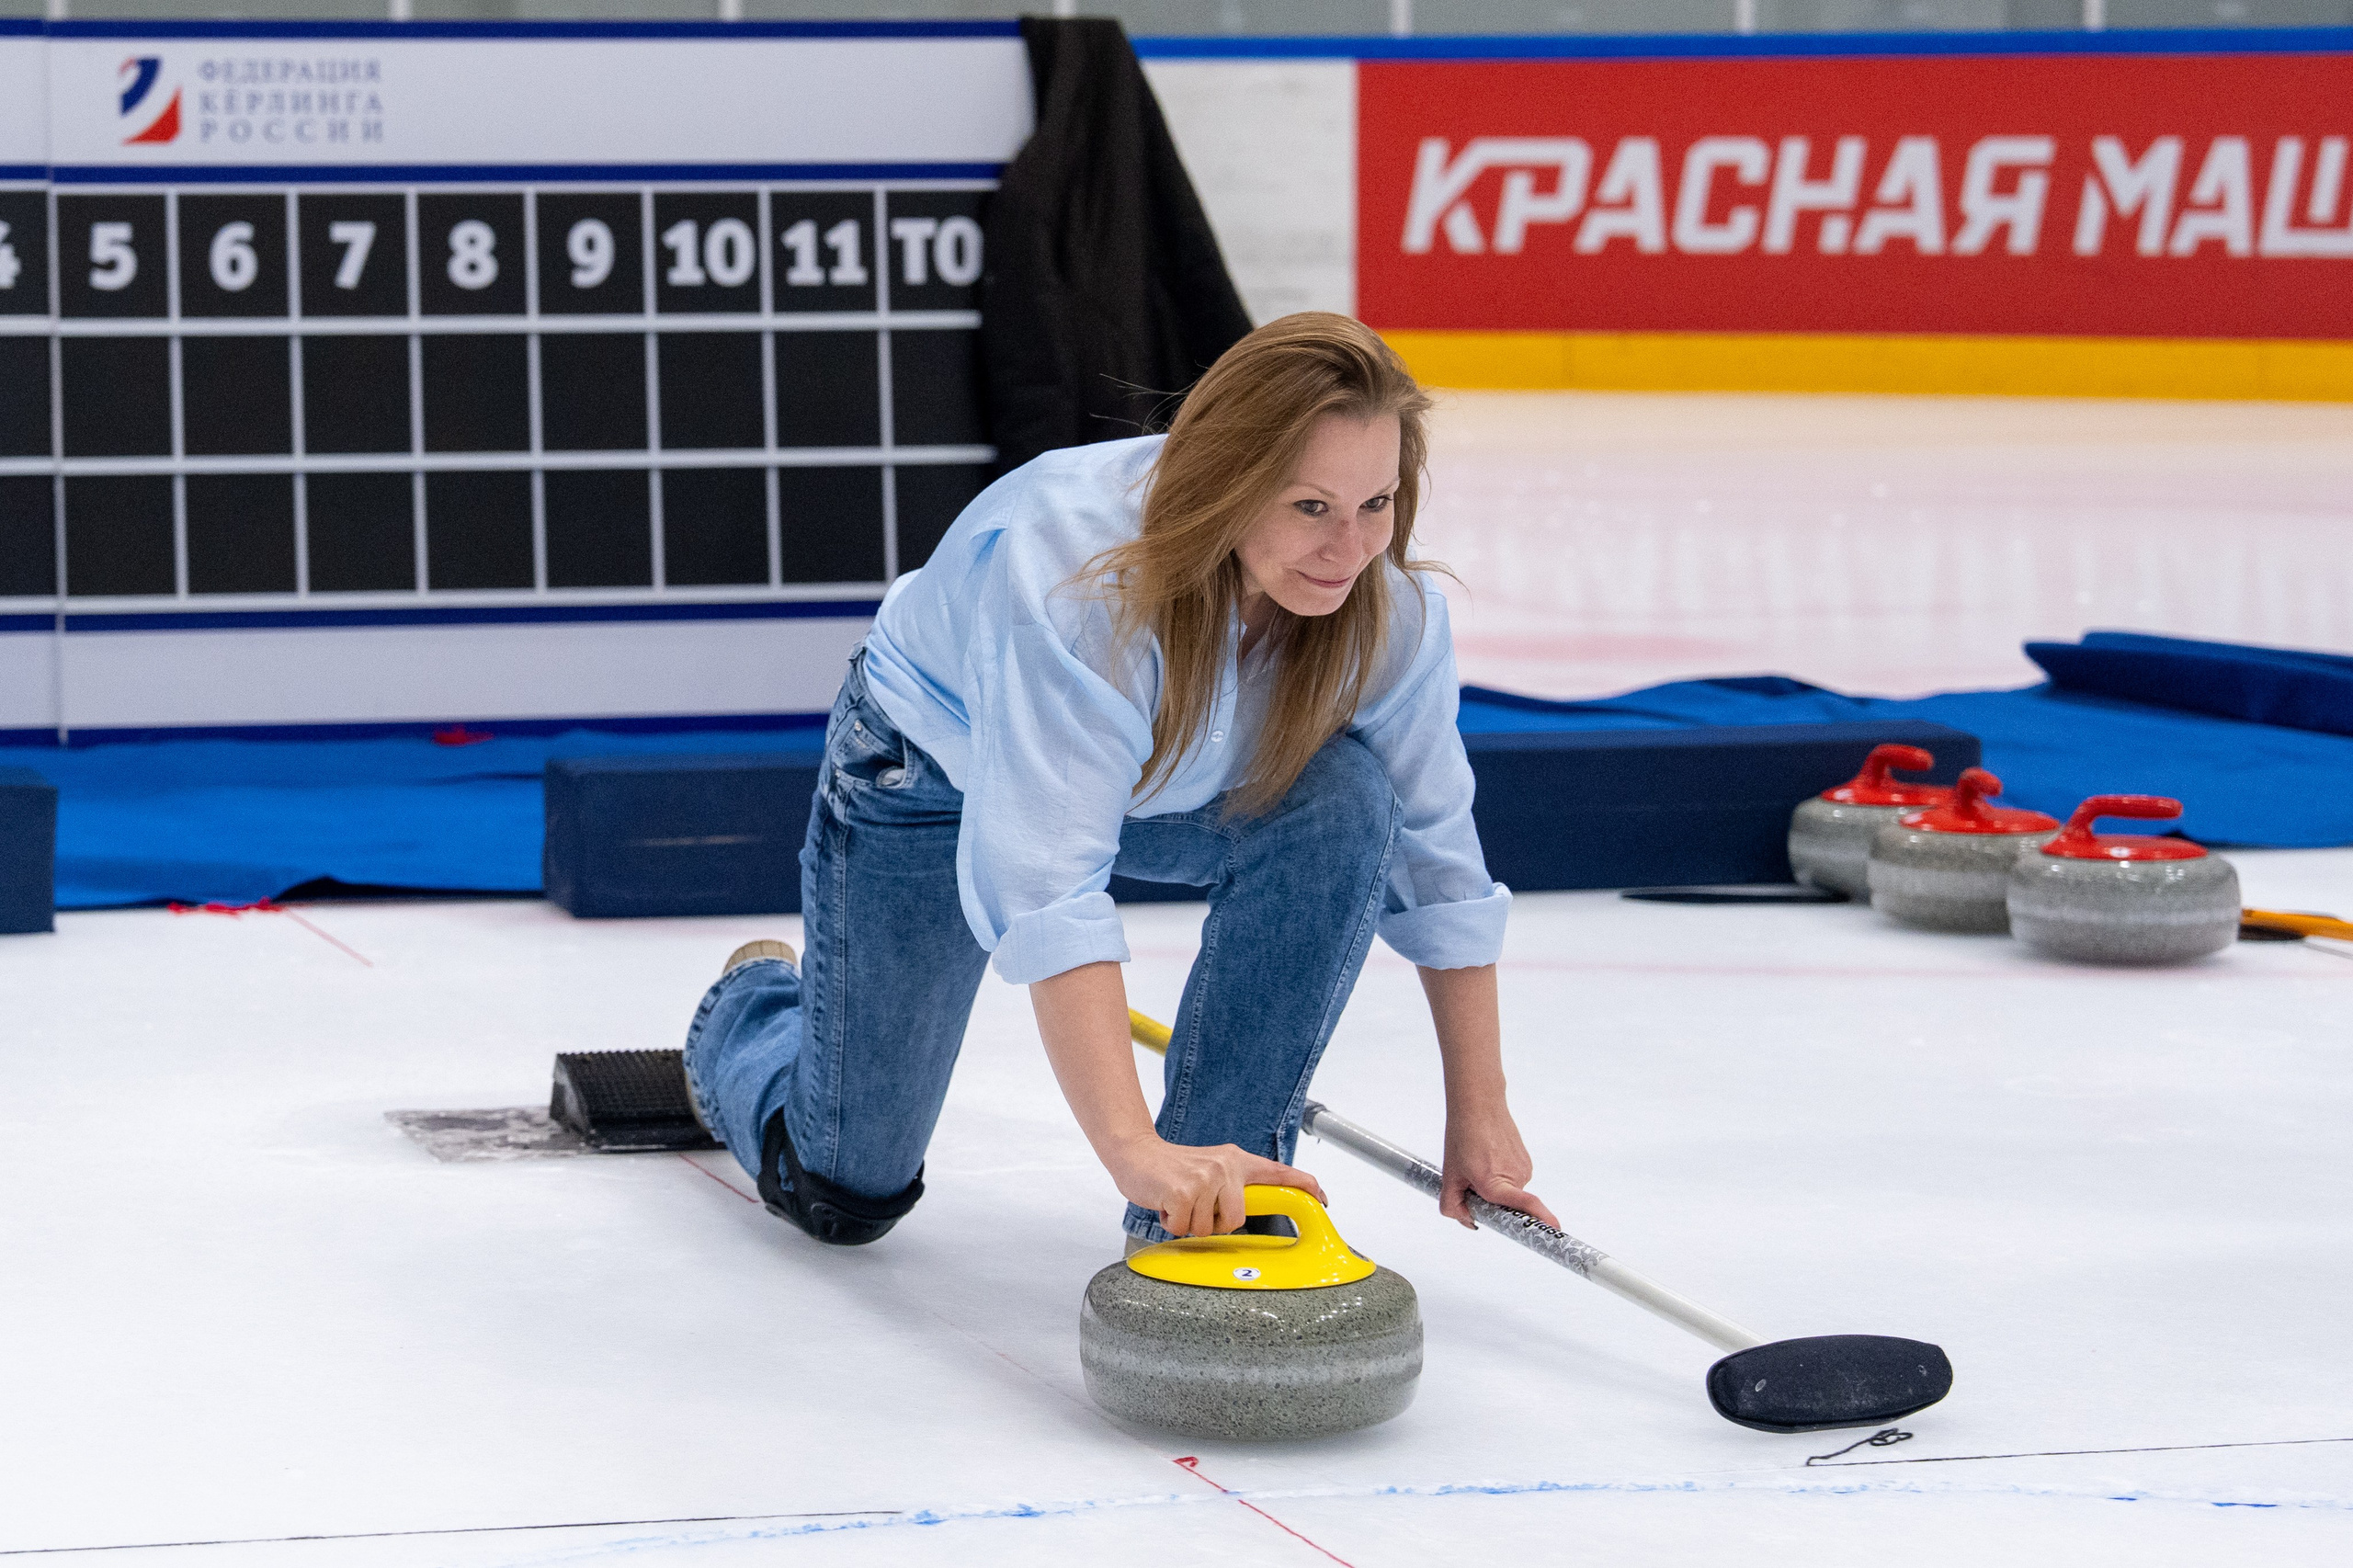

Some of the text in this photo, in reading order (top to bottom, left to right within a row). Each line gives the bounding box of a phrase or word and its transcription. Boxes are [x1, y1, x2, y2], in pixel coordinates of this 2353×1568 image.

[198, 59, 381, 84] ФЕДЕРАЦИЯ
[199, 118, 383, 143] РОССИИ
[1401, 135, 2057, 256] КРАСНАЯ
[90, 222, 138, 290] 5
[210, 222, 258, 291] 6
[329, 222, 376, 290] 7
[448, 220, 498, 290] 8
[567, 219, 615, 288] 9
[663, 218, 756, 287] 10
[782, 220, 868, 286] 11
